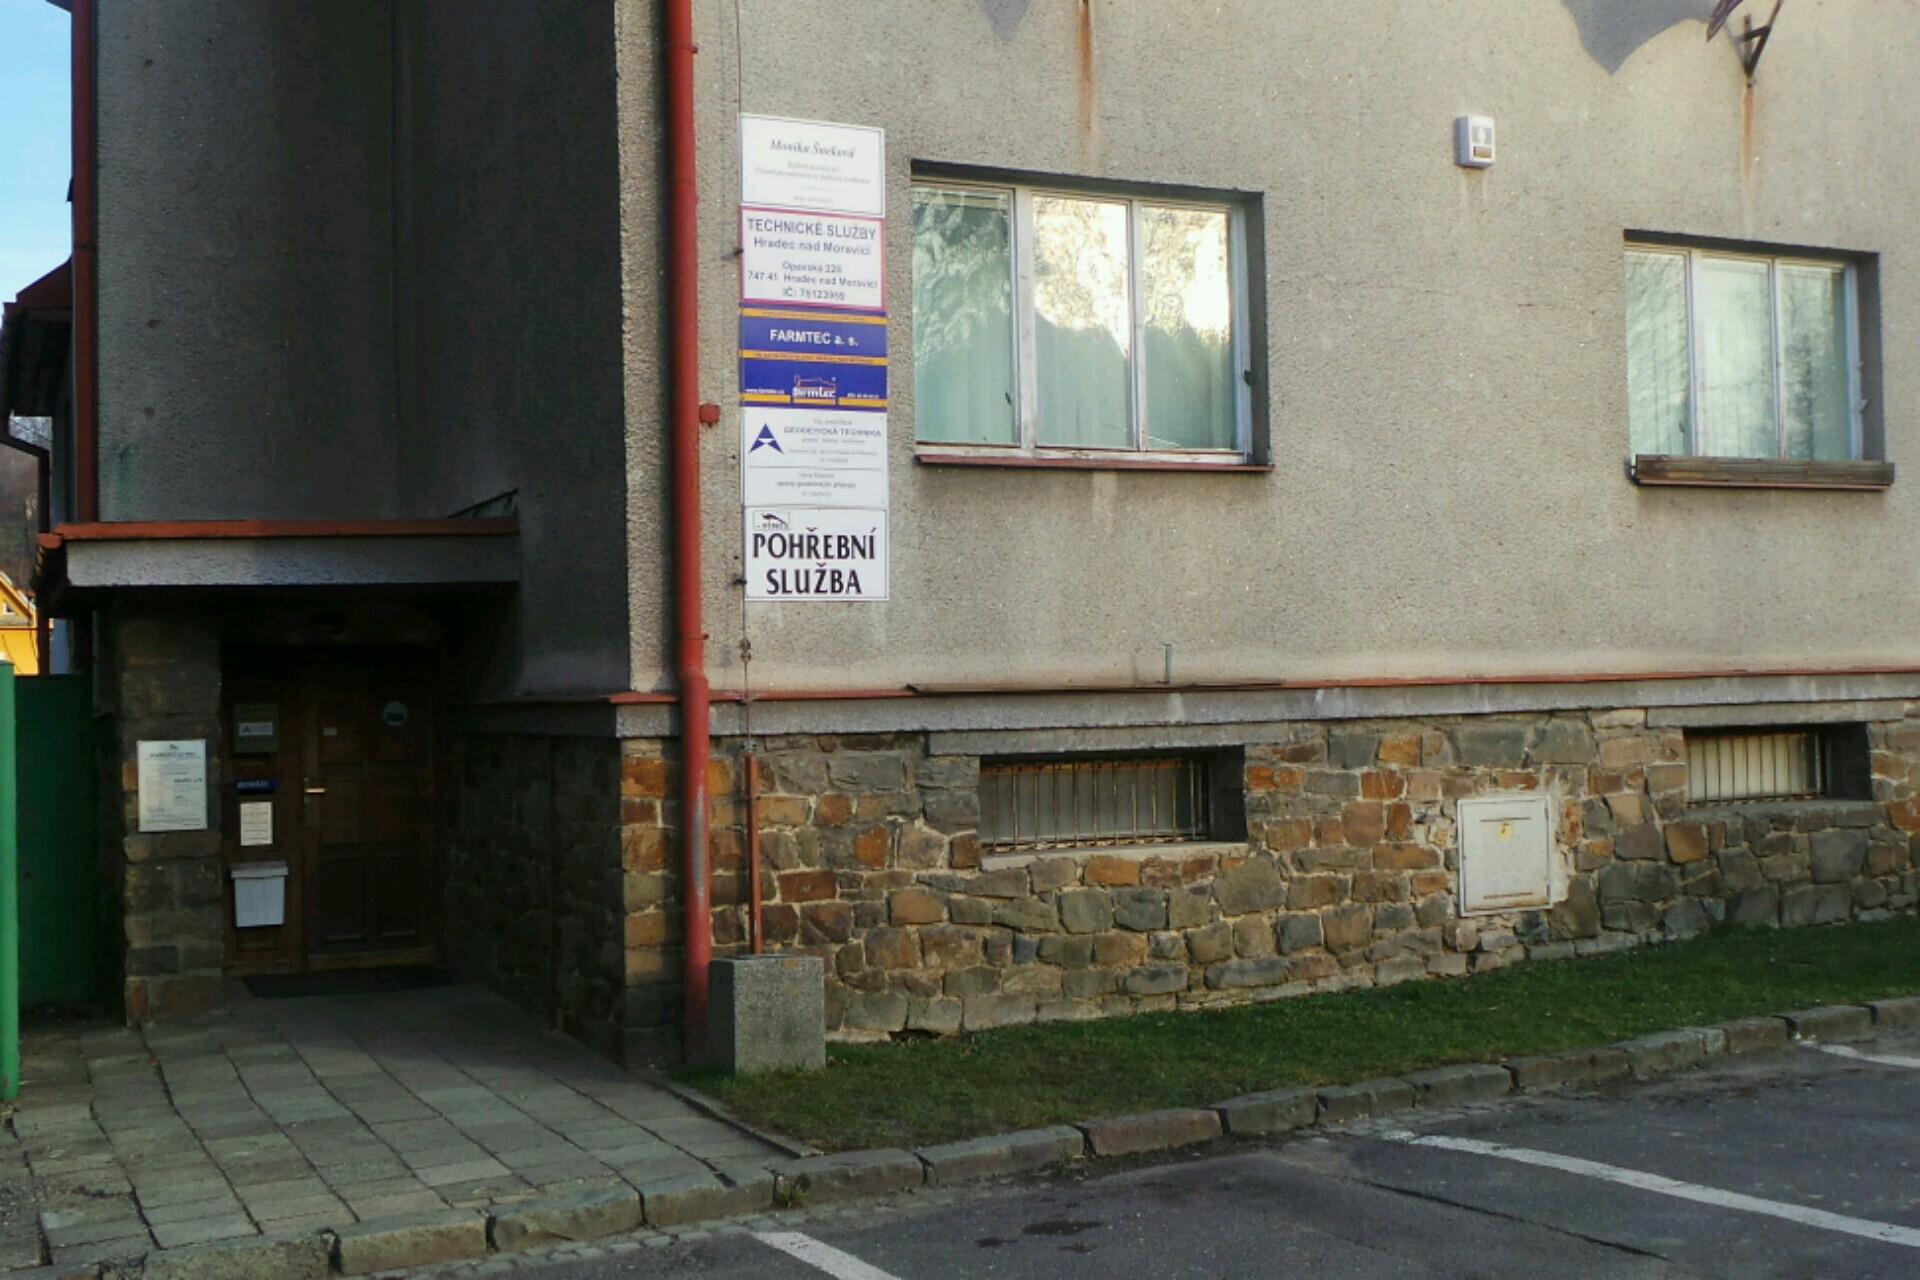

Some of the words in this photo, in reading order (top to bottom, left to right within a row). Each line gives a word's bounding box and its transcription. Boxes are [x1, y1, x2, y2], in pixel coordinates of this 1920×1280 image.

[747, 218, 822, 236] TECHNICKÉ
[827, 223, 876, 240] SLUŽBY
[754, 236, 795, 249] Hradec
[799, 241, 821, 252] nad
[819, 276, 836, 285] nad
[770, 329, 831, 345] FARMTEC
[834, 335, 845, 345] a.
[847, 336, 859, 347] s.
[753, 527, 877, 560] POHŘEBNÍ
[766, 562, 862, 595] SLUŽBA
